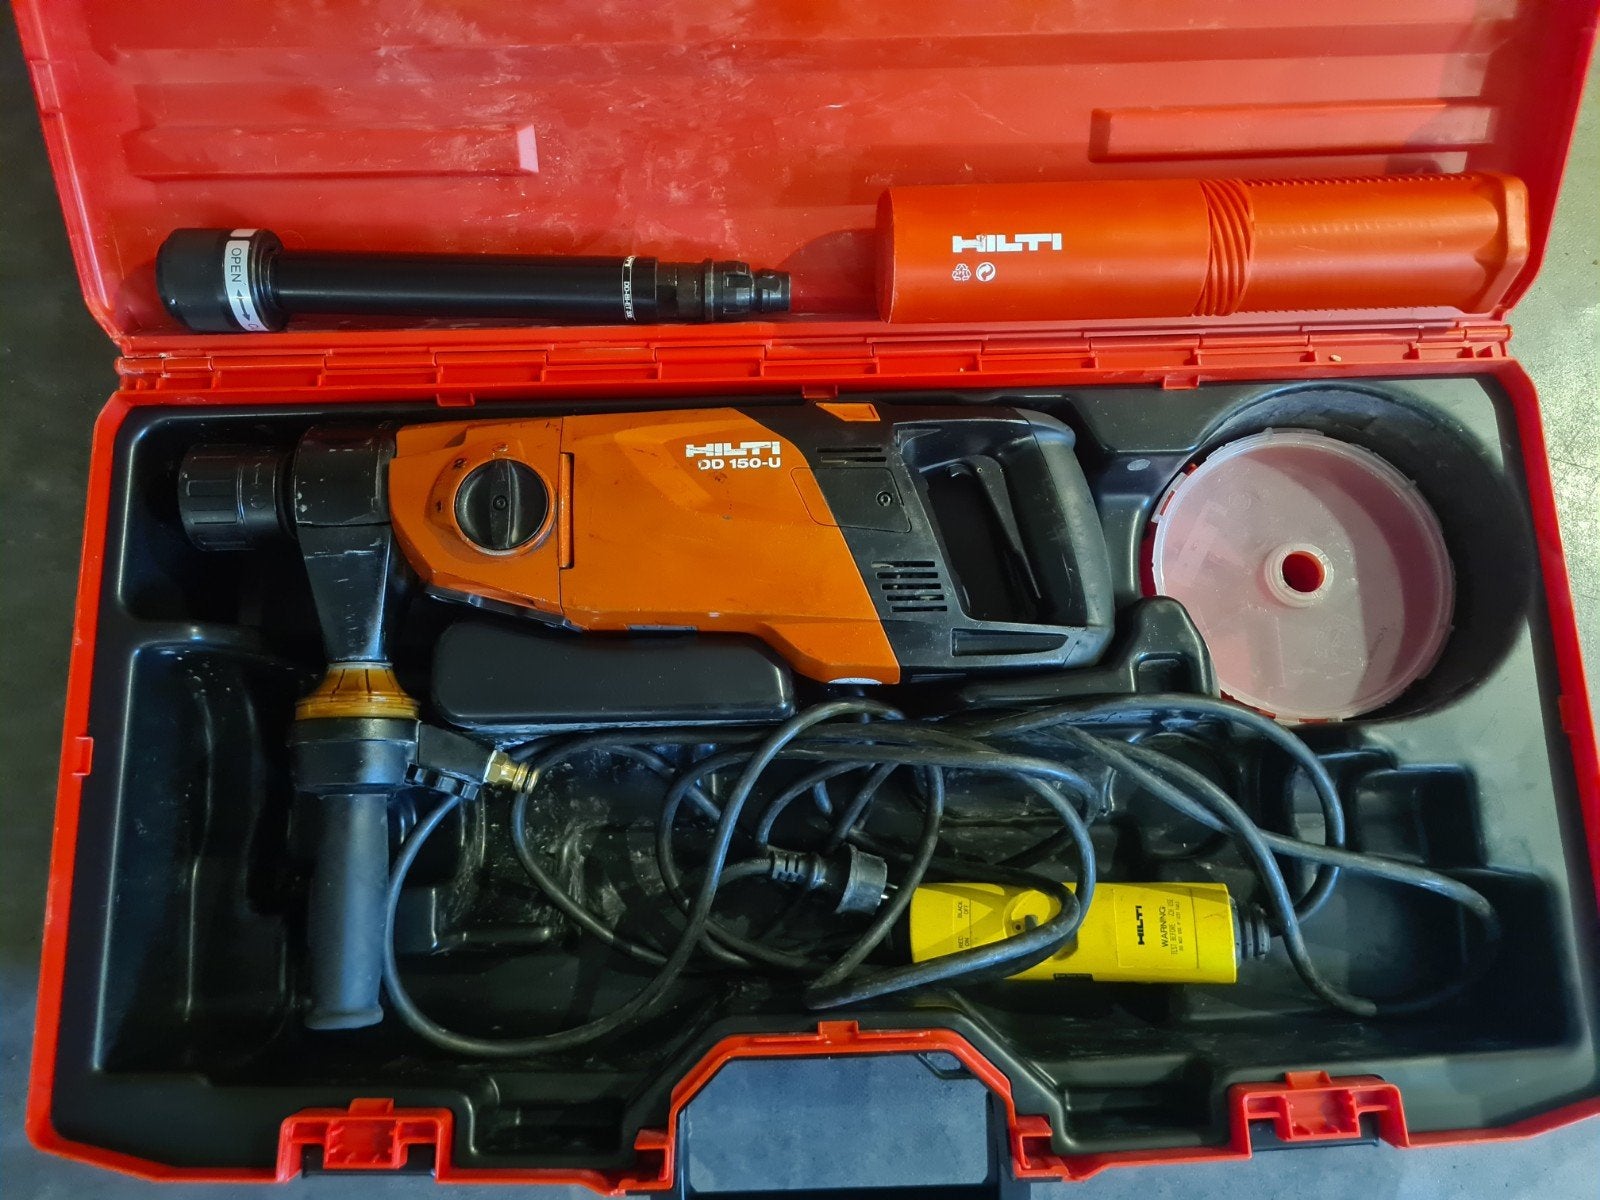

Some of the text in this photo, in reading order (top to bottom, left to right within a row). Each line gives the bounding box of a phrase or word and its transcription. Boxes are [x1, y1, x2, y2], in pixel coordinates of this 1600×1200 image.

[952, 233, 1062, 253] HILTI
[231, 247, 242, 283] OPEN
[685, 441, 781, 458] HILTI
[729, 457, 781, 469] 150-U
[1136, 905, 1144, 945] HILTI
[1159, 907, 1168, 947] WARNING
